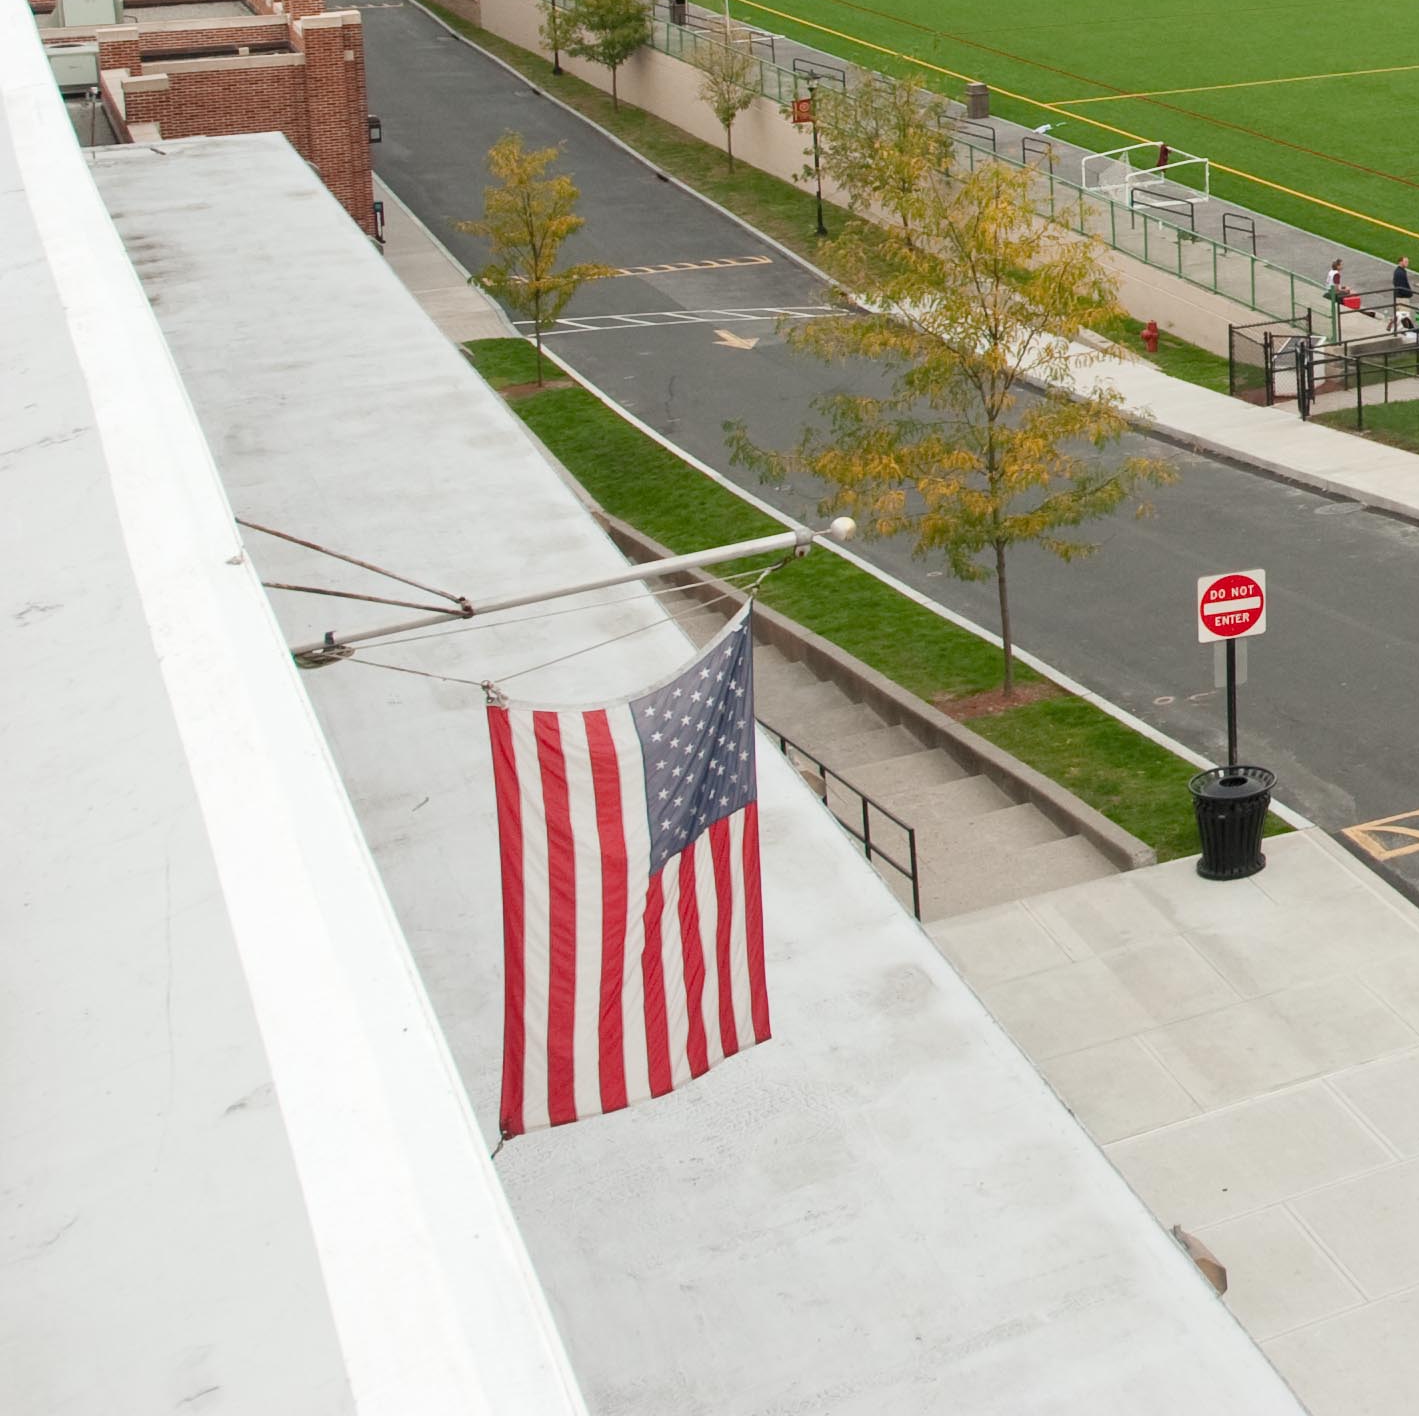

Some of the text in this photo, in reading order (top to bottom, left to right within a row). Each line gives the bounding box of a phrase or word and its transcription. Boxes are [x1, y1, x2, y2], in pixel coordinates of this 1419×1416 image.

[1210, 584, 1255, 600] DO NOT
[1215, 612, 1250, 627] ENTER
